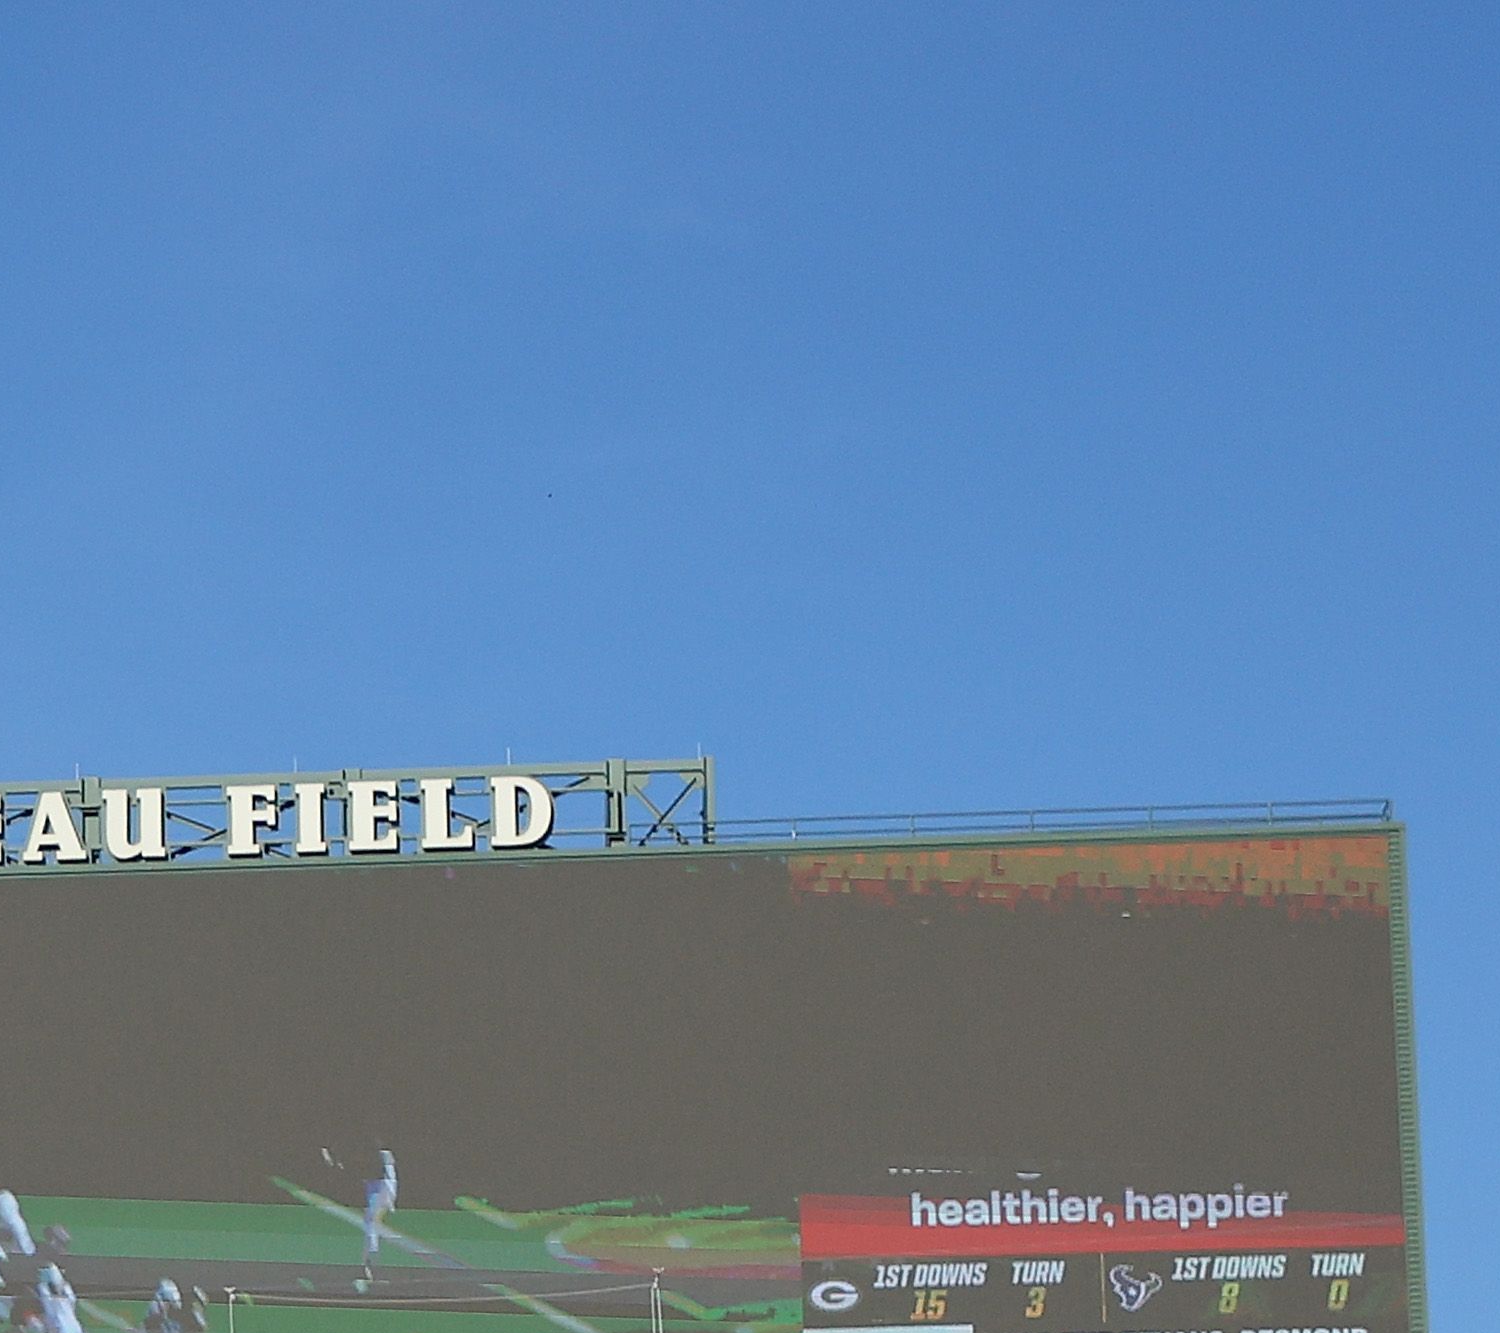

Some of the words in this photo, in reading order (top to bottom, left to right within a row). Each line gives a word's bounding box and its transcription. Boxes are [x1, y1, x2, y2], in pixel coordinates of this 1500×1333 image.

[225, 774, 555, 859] FIELD
[911, 1189, 1115, 1227] healthier,
[1125, 1184, 1289, 1231] happier
[874, 1265, 910, 1289] 1ST
[913, 1262, 988, 1288] DOWNS
[1011, 1260, 1066, 1286] TURN
[1170, 1257, 1210, 1282] 1ST
[1212, 1254, 1288, 1280] DOWNS
[1310, 1252, 1366, 1278] TURN
[909, 1289, 947, 1321] 15
[1024, 1286, 1046, 1318] 3
[1218, 1282, 1240, 1314] 8
[1327, 1278, 1350, 1311] 0
